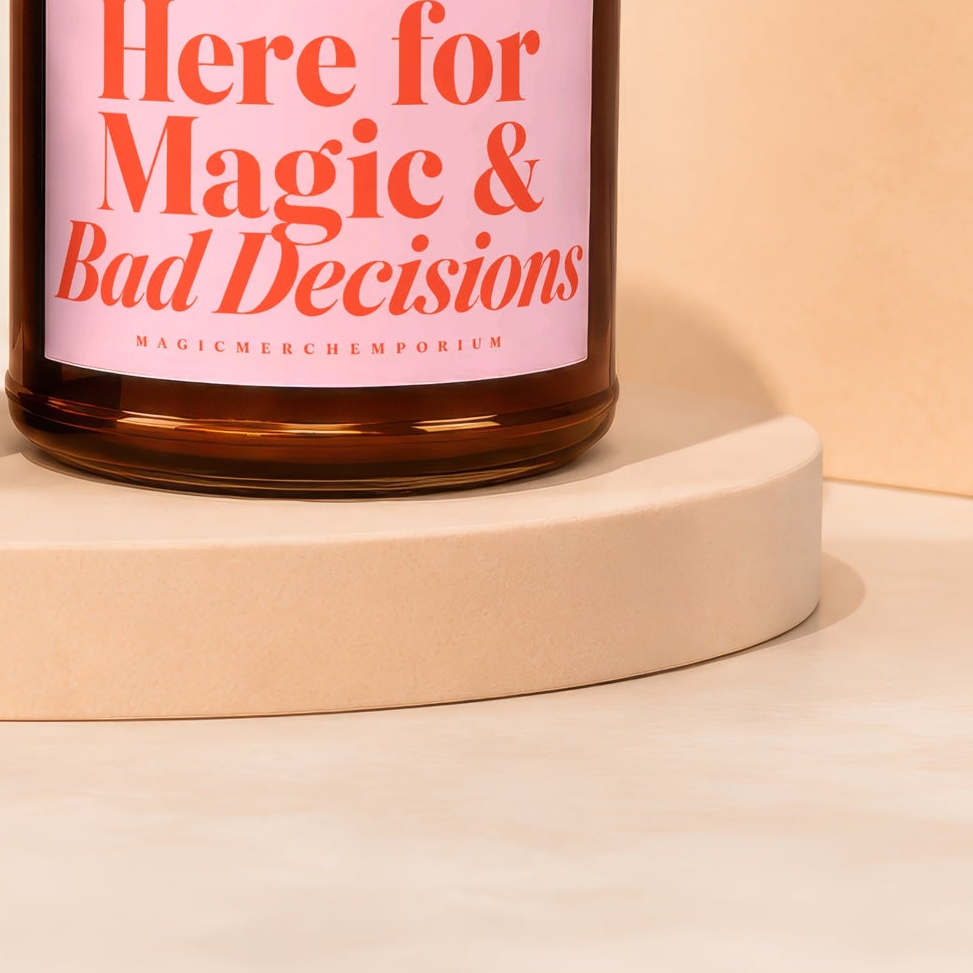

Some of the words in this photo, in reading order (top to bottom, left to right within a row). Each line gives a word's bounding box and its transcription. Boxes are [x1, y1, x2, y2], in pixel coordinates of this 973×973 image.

[97, 111, 444, 246] Magic
[473, 120, 545, 217] &
[55, 219, 214, 313] Bad
[212, 230, 585, 318] Decisions
[135, 335, 504, 356] MAGICMERCHEMPORIUM
